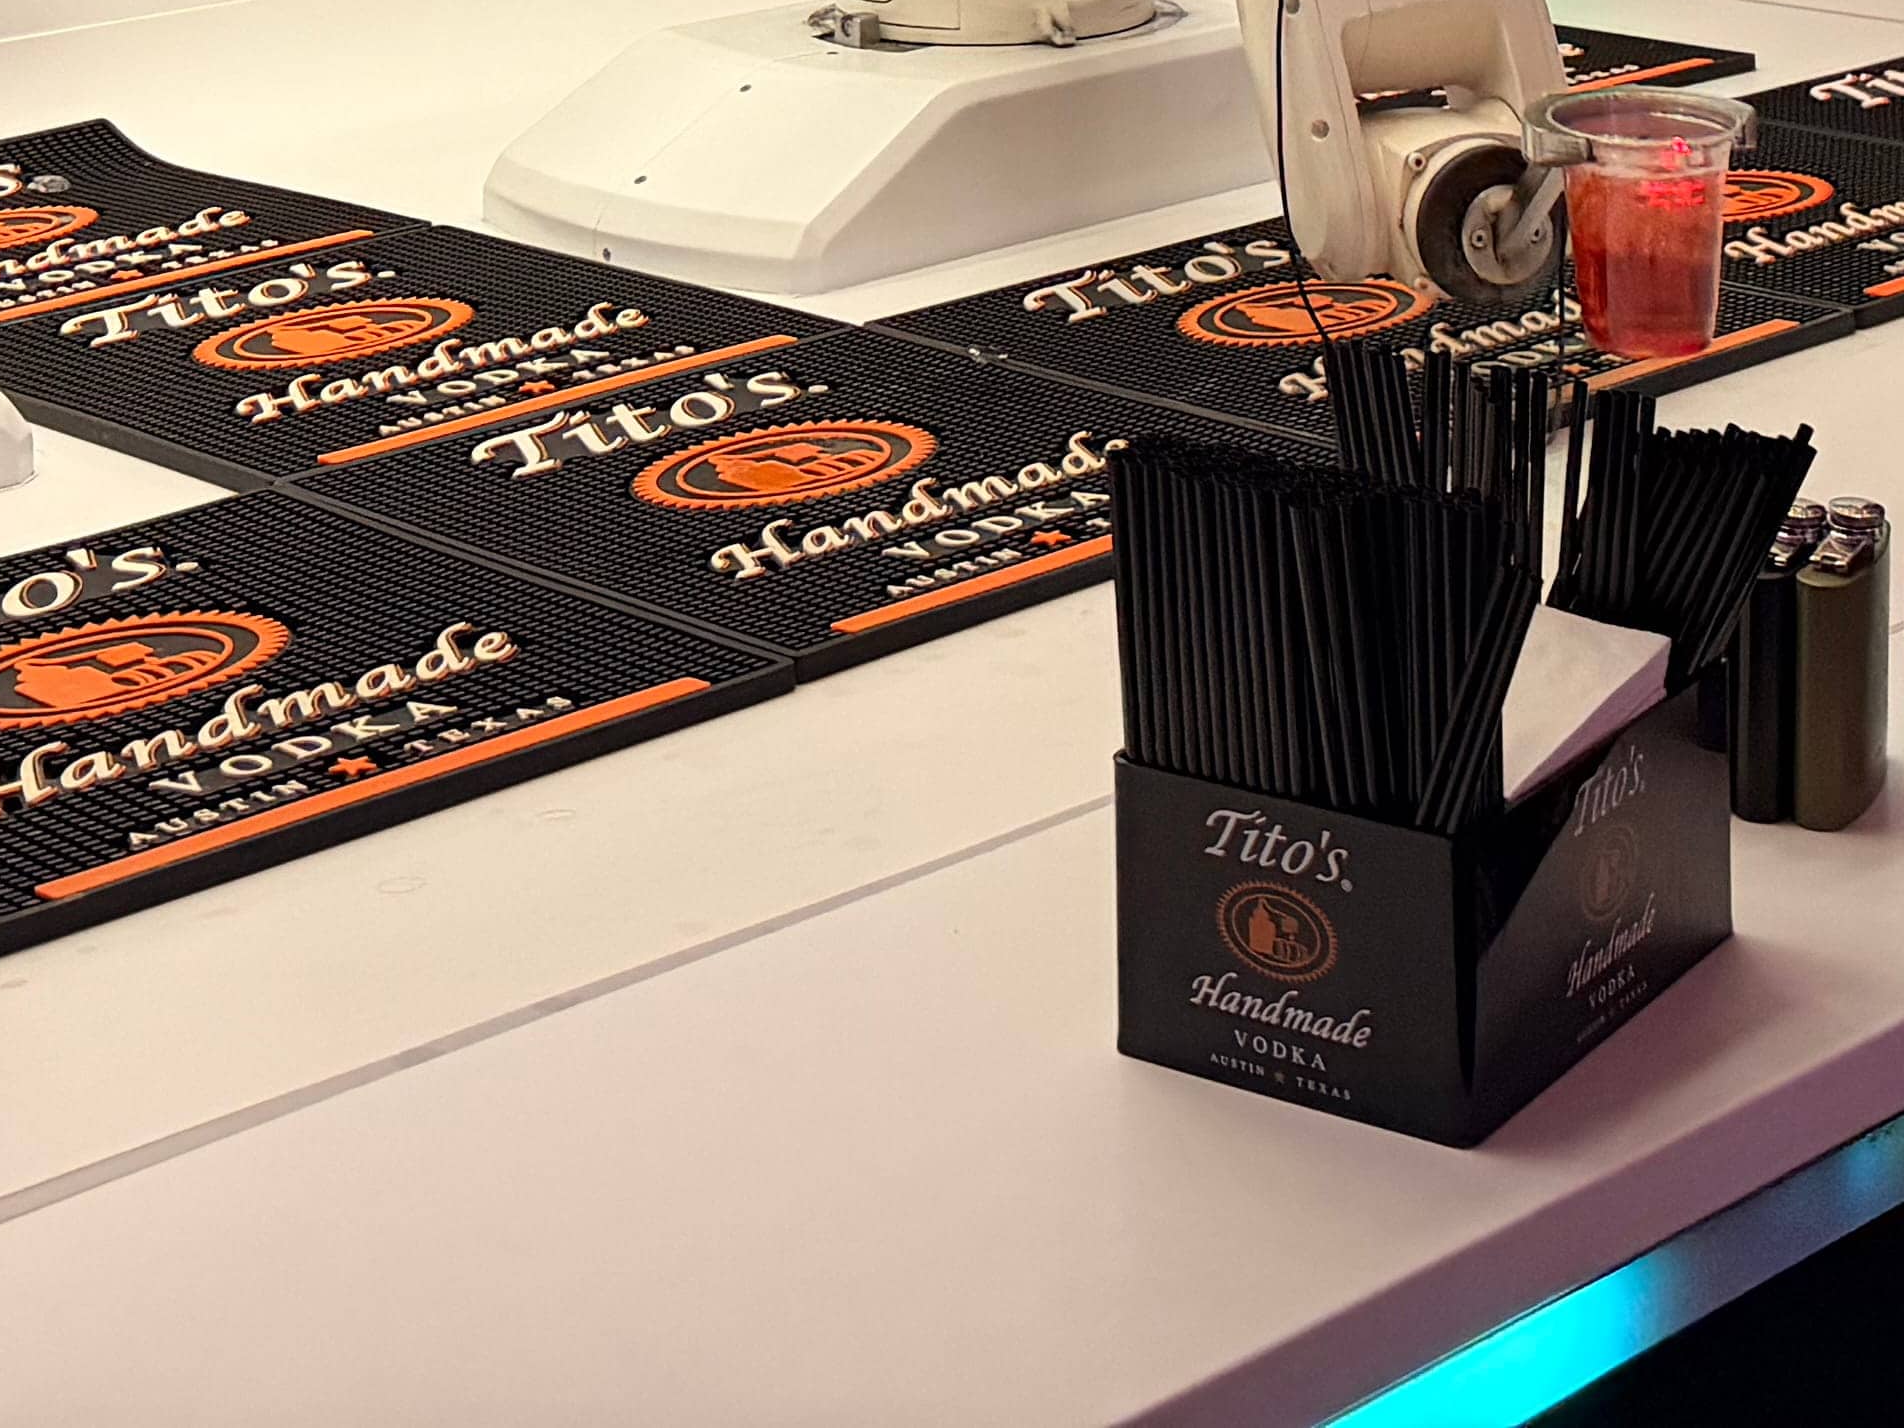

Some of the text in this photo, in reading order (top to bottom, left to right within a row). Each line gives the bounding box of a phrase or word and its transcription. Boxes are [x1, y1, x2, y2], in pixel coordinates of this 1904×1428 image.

[237, 300, 648, 423] Handmade
[387, 346, 612, 408] VODKA
[379, 394, 506, 438] AUSTIN
[711, 431, 1129, 580] Handmade
[884, 490, 1107, 562] VODKA
[887, 547, 1021, 596] AUSTIN
[128, 694, 574, 849] AUSTIN TEXAS
[150, 694, 457, 798] VODKA
[1189, 974, 1372, 1052] Handmade
[1208, 1053, 1352, 1101] AUSTIN TEXAS
[1233, 1030, 1327, 1073] VODKA
